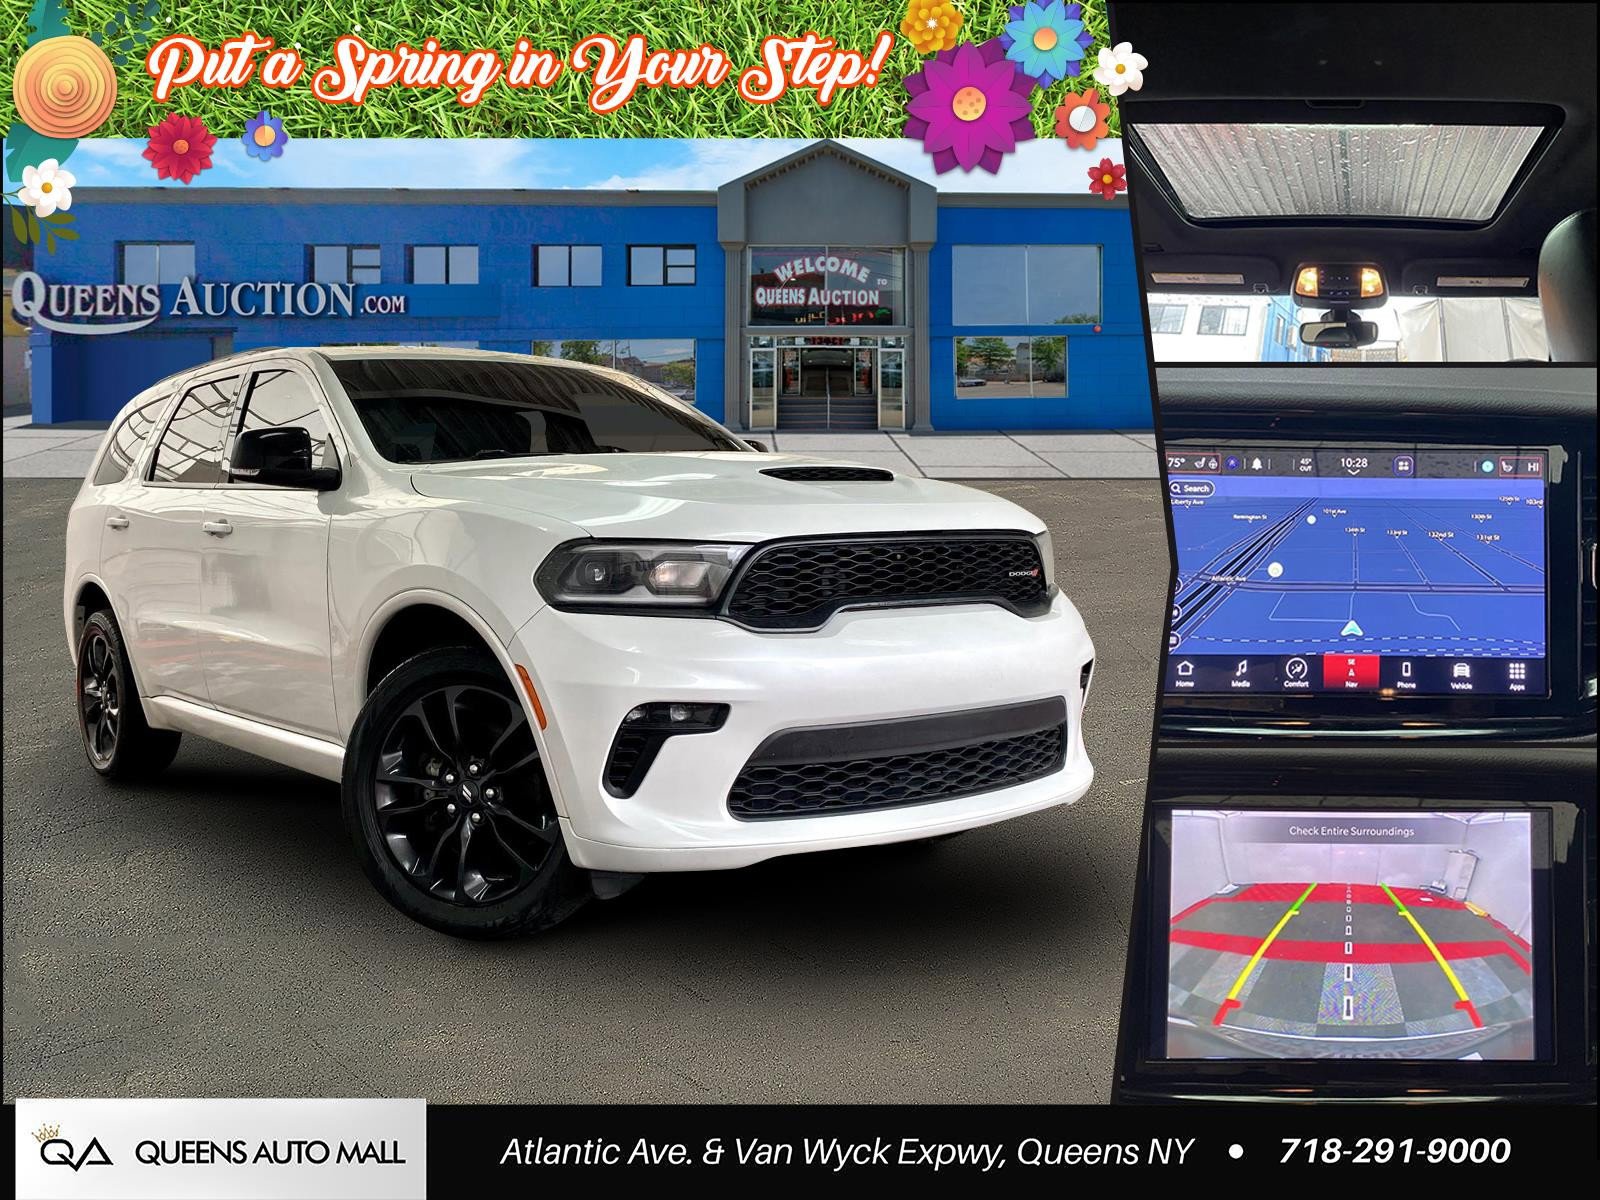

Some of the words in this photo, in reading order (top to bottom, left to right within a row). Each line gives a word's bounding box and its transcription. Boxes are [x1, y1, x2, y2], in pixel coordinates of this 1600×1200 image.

[774, 256, 871, 284] WELCOME
[755, 286, 806, 307] QUEENS
[808, 287, 880, 306] AUCTION
[12, 271, 161, 335] QUEENS
[1341, 457, 1368, 468] 10:28
[1527, 462, 1540, 472] HI
[1299, 465, 1313, 473] OUT
[1183, 483, 1210, 494] Search
[1171, 499, 1191, 507] Liberty
[1450, 682, 1473, 690] Vehicle
[1509, 683, 1525, 691] Apps
[1289, 825, 1319, 836] Check
[1320, 826, 1349, 836] Entire
[1350, 826, 1415, 838] Surroundings
